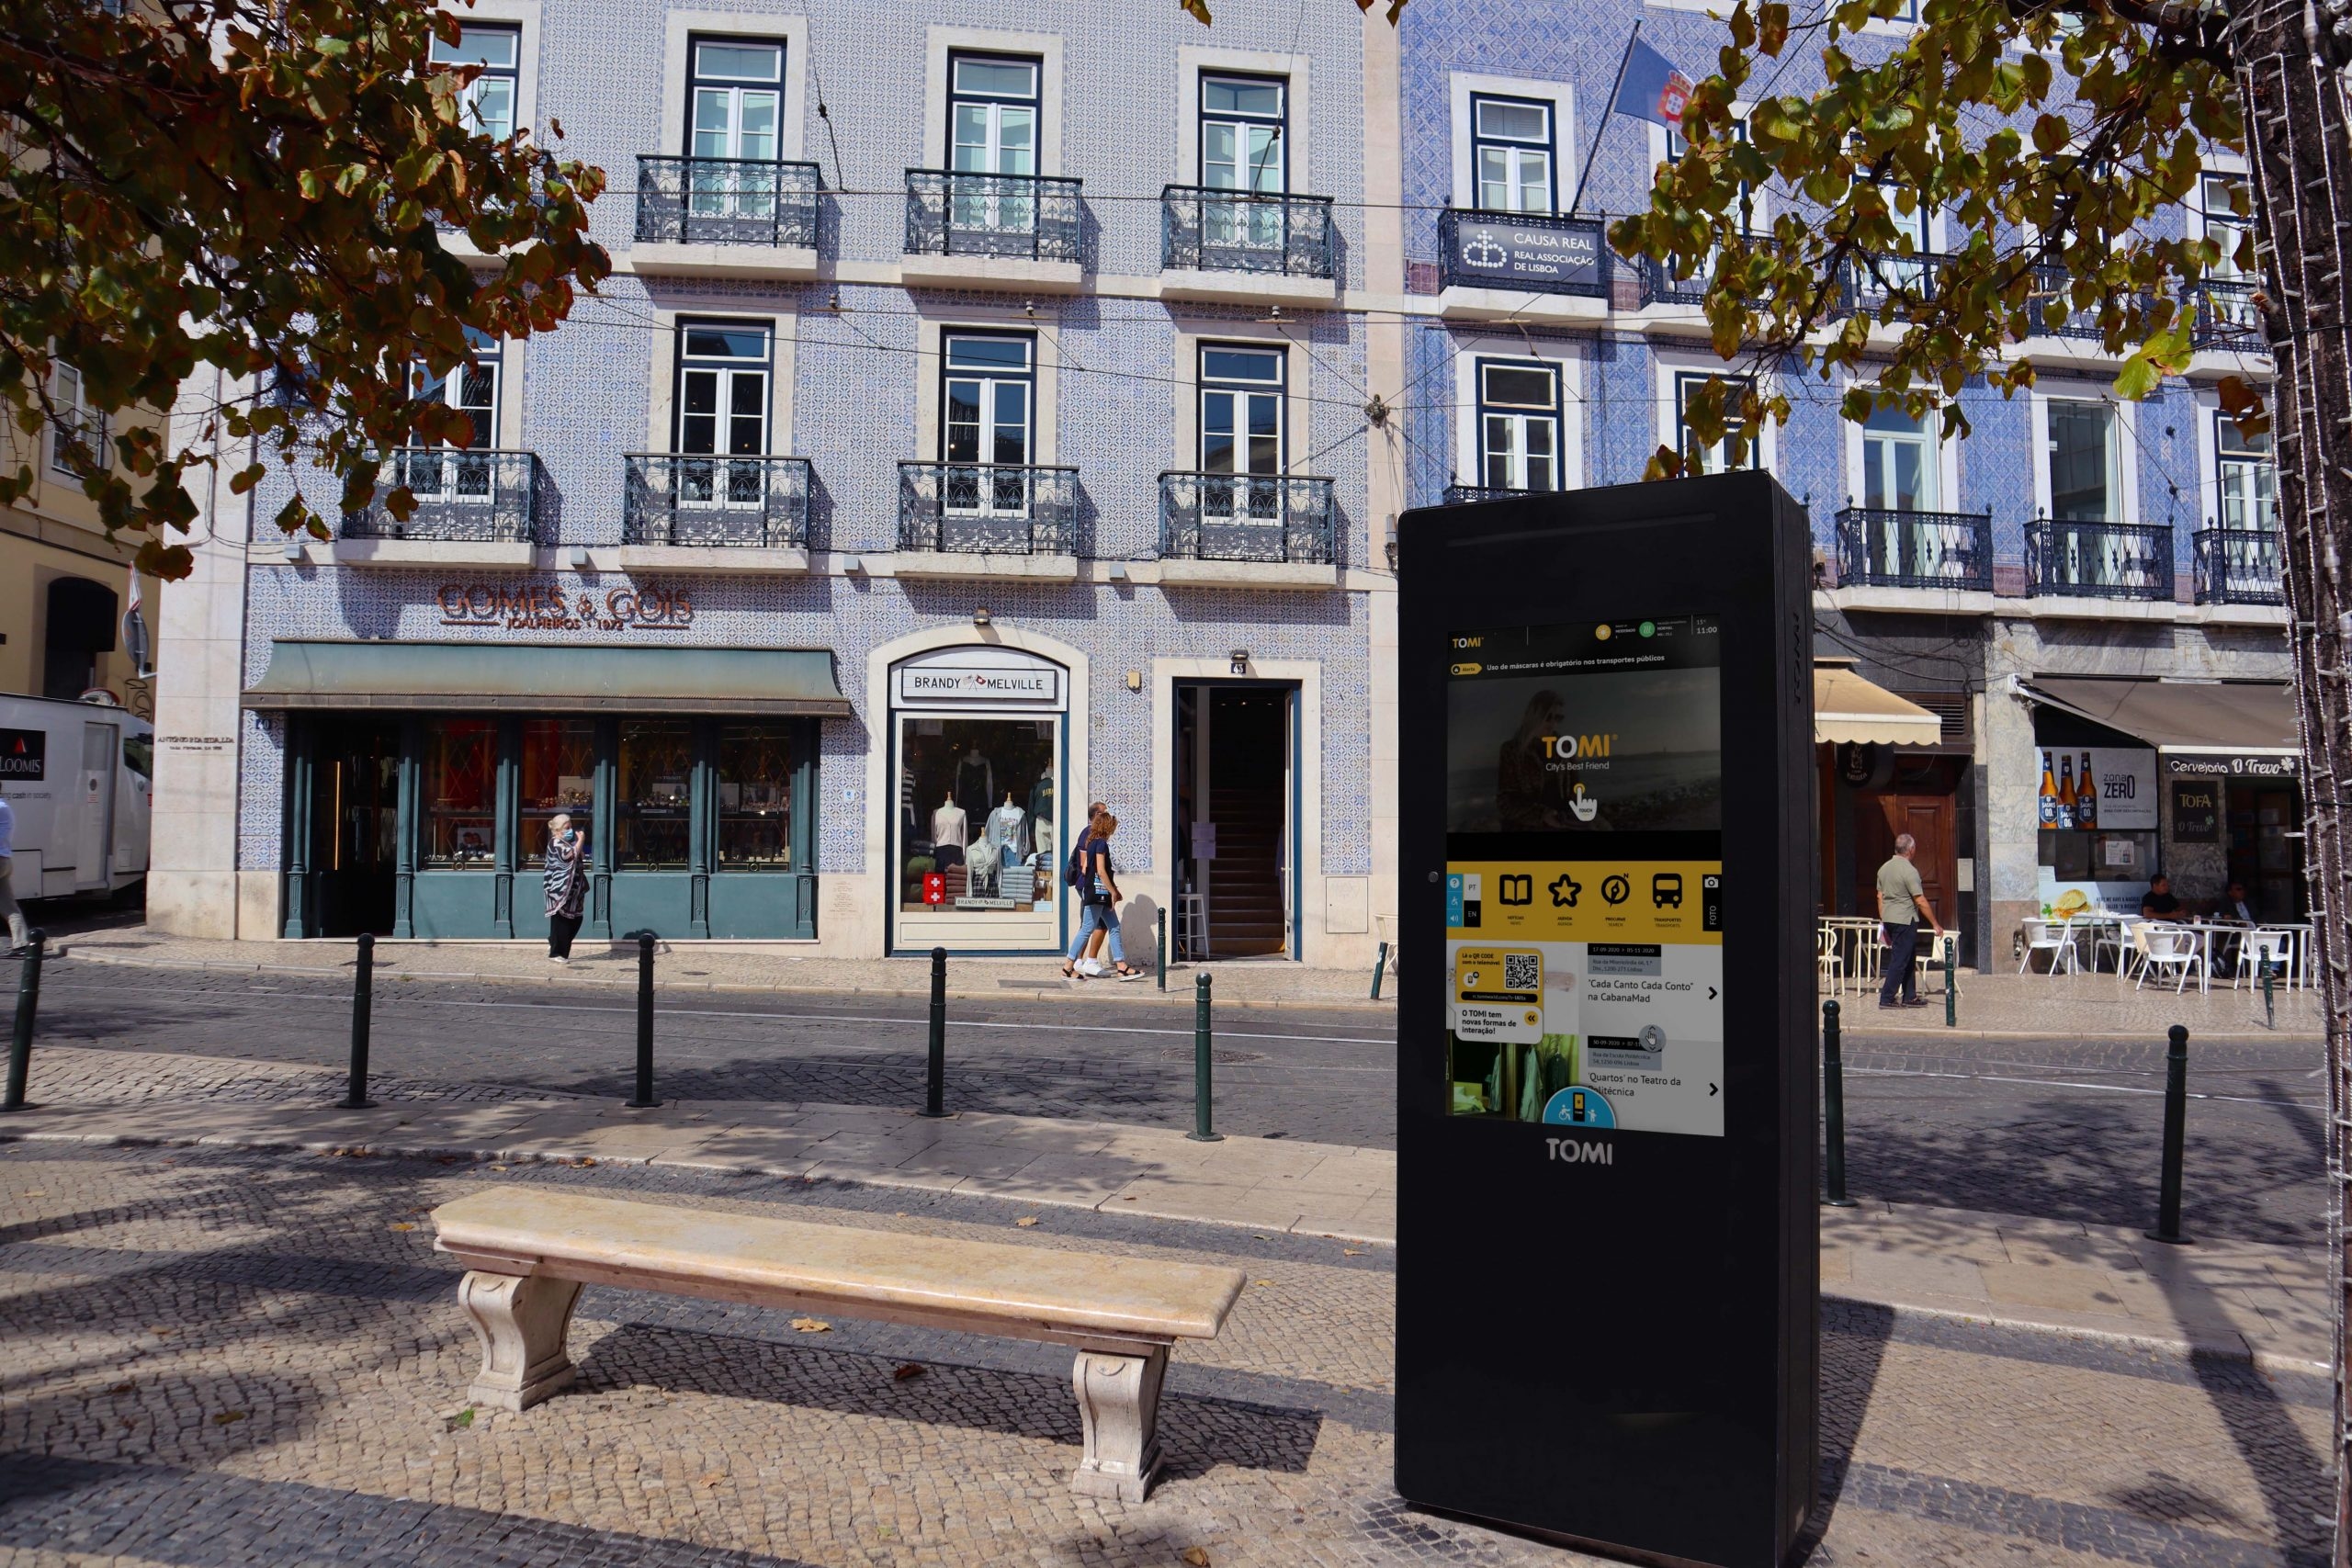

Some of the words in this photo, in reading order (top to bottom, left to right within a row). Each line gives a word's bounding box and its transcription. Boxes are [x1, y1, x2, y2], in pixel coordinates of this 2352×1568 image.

[1514, 232, 1559, 247] CAUSA
[1562, 237, 1594, 251] REAL
[1514, 251, 1535, 260] REAL
[1536, 253, 1595, 265] ASSOCIAÇÃO
[1514, 262, 1526, 271] DE
[1528, 263, 1559, 274] LISBOA
[436, 584, 564, 614] GOMES
[576, 593, 594, 615] &
[1696, 626, 1718, 635] 11:00
[1452, 637, 1482, 649] TOMI
[1510, 661, 1539, 670] máscaras
[1540, 660, 1544, 669] é
[1545, 659, 1582, 669] obrigatório
[1596, 656, 1635, 665] transportes
[1635, 654, 1666, 664] públicos
[914, 676, 961, 689] BRANDY
[987, 678, 1044, 690] MELVILLE
[1541, 734, 1611, 759] TOMI
[0, 755, 41, 773] LOOMIS
[1545, 762, 1566, 773] City's
[1566, 762, 1584, 771] Best
[1585, 761, 1611, 771] Friend
[2170, 760, 2229, 775] Cervejaria
[2232, 758, 2244, 773] O
[2245, 759, 2282, 774] Trevo
[2178, 794, 2212, 808] TOFA
[1709, 905, 1717, 926] FOTO
[1613, 980, 1639, 989] Canto
[1641, 981, 1662, 990] Cada
[1665, 982, 1694, 991] Conto"
[1600, 992, 1651, 1003] CabanaMad
[1483, 1019, 1507, 1027] formas
[1462, 1027, 1496, 1035] interação!
[1640, 1076, 1668, 1086] Teatro
[1670, 1077, 1681, 1086] da
[1545, 1137, 1613, 1166] TOMI
